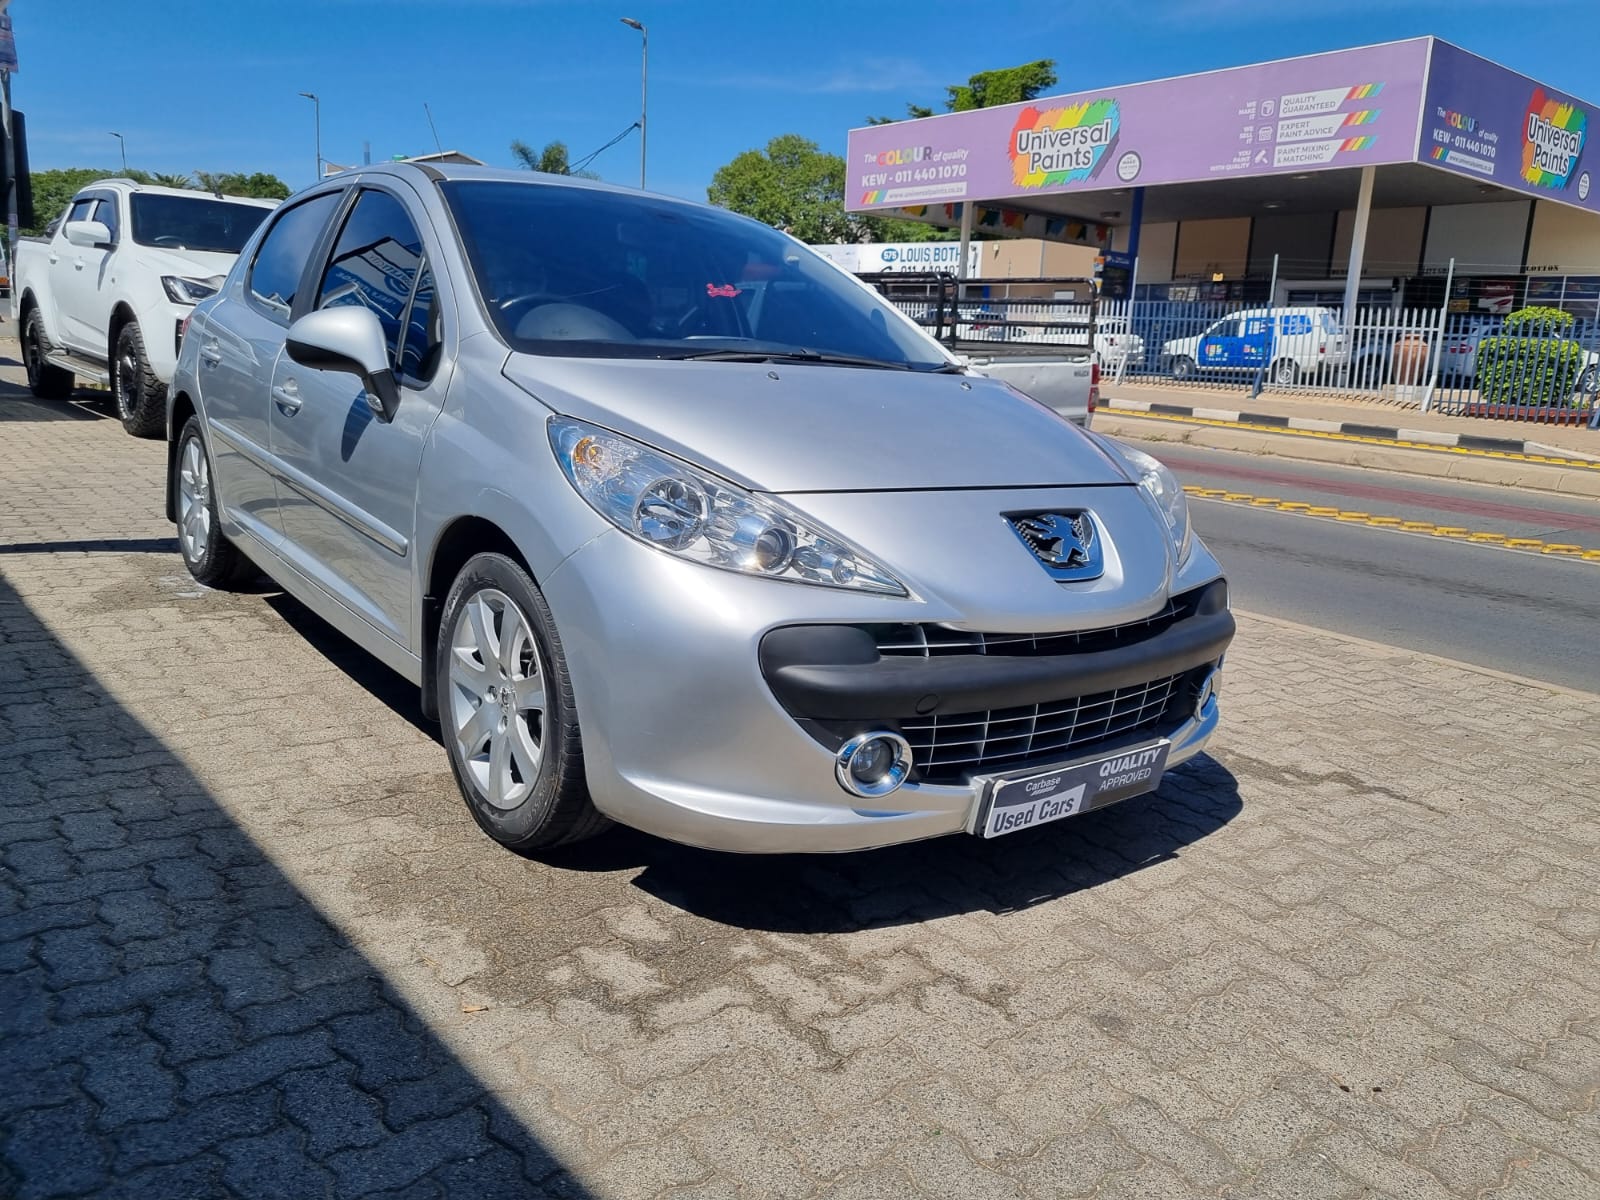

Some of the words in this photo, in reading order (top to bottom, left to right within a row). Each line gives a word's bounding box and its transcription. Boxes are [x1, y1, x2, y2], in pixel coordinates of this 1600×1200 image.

[1282, 101, 1336, 114] GUARANTEED
[1283, 95, 1317, 106] QUALITY
[1280, 121, 1310, 131] EXPERT
[1280, 130, 1303, 139] PAINT
[1303, 126, 1334, 137] ADVICE
[1445, 110, 1479, 133] COLOUR
[1018, 120, 1110, 153] Universal
[1433, 128, 1451, 144] KEW
[1455, 135, 1466, 149] 011
[1466, 140, 1480, 153] 440
[1480, 143, 1496, 158] 1070
[1528, 115, 1581, 154] Universal
[864, 153, 877, 164] The
[877, 146, 932, 166] COLOUR
[1031, 147, 1092, 172] Paints
[1277, 146, 1301, 155] PAINT
[1302, 143, 1330, 153] MIXING
[1282, 152, 1325, 162] MATCHING
[1534, 143, 1569, 175] Paints
[862, 173, 887, 188] KEW
[895, 170, 912, 183] 011
[914, 167, 937, 181] 440
[938, 164, 967, 179] 1070
[900, 247, 931, 262] LOUIS
[933, 246, 961, 262] BOTH
[1099, 748, 1163, 777] QUALITY
[1025, 776, 1062, 793] Carbase
[1099, 767, 1152, 791] APPROVED
[993, 803, 1034, 834] Used
[1038, 797, 1075, 821] Cars
